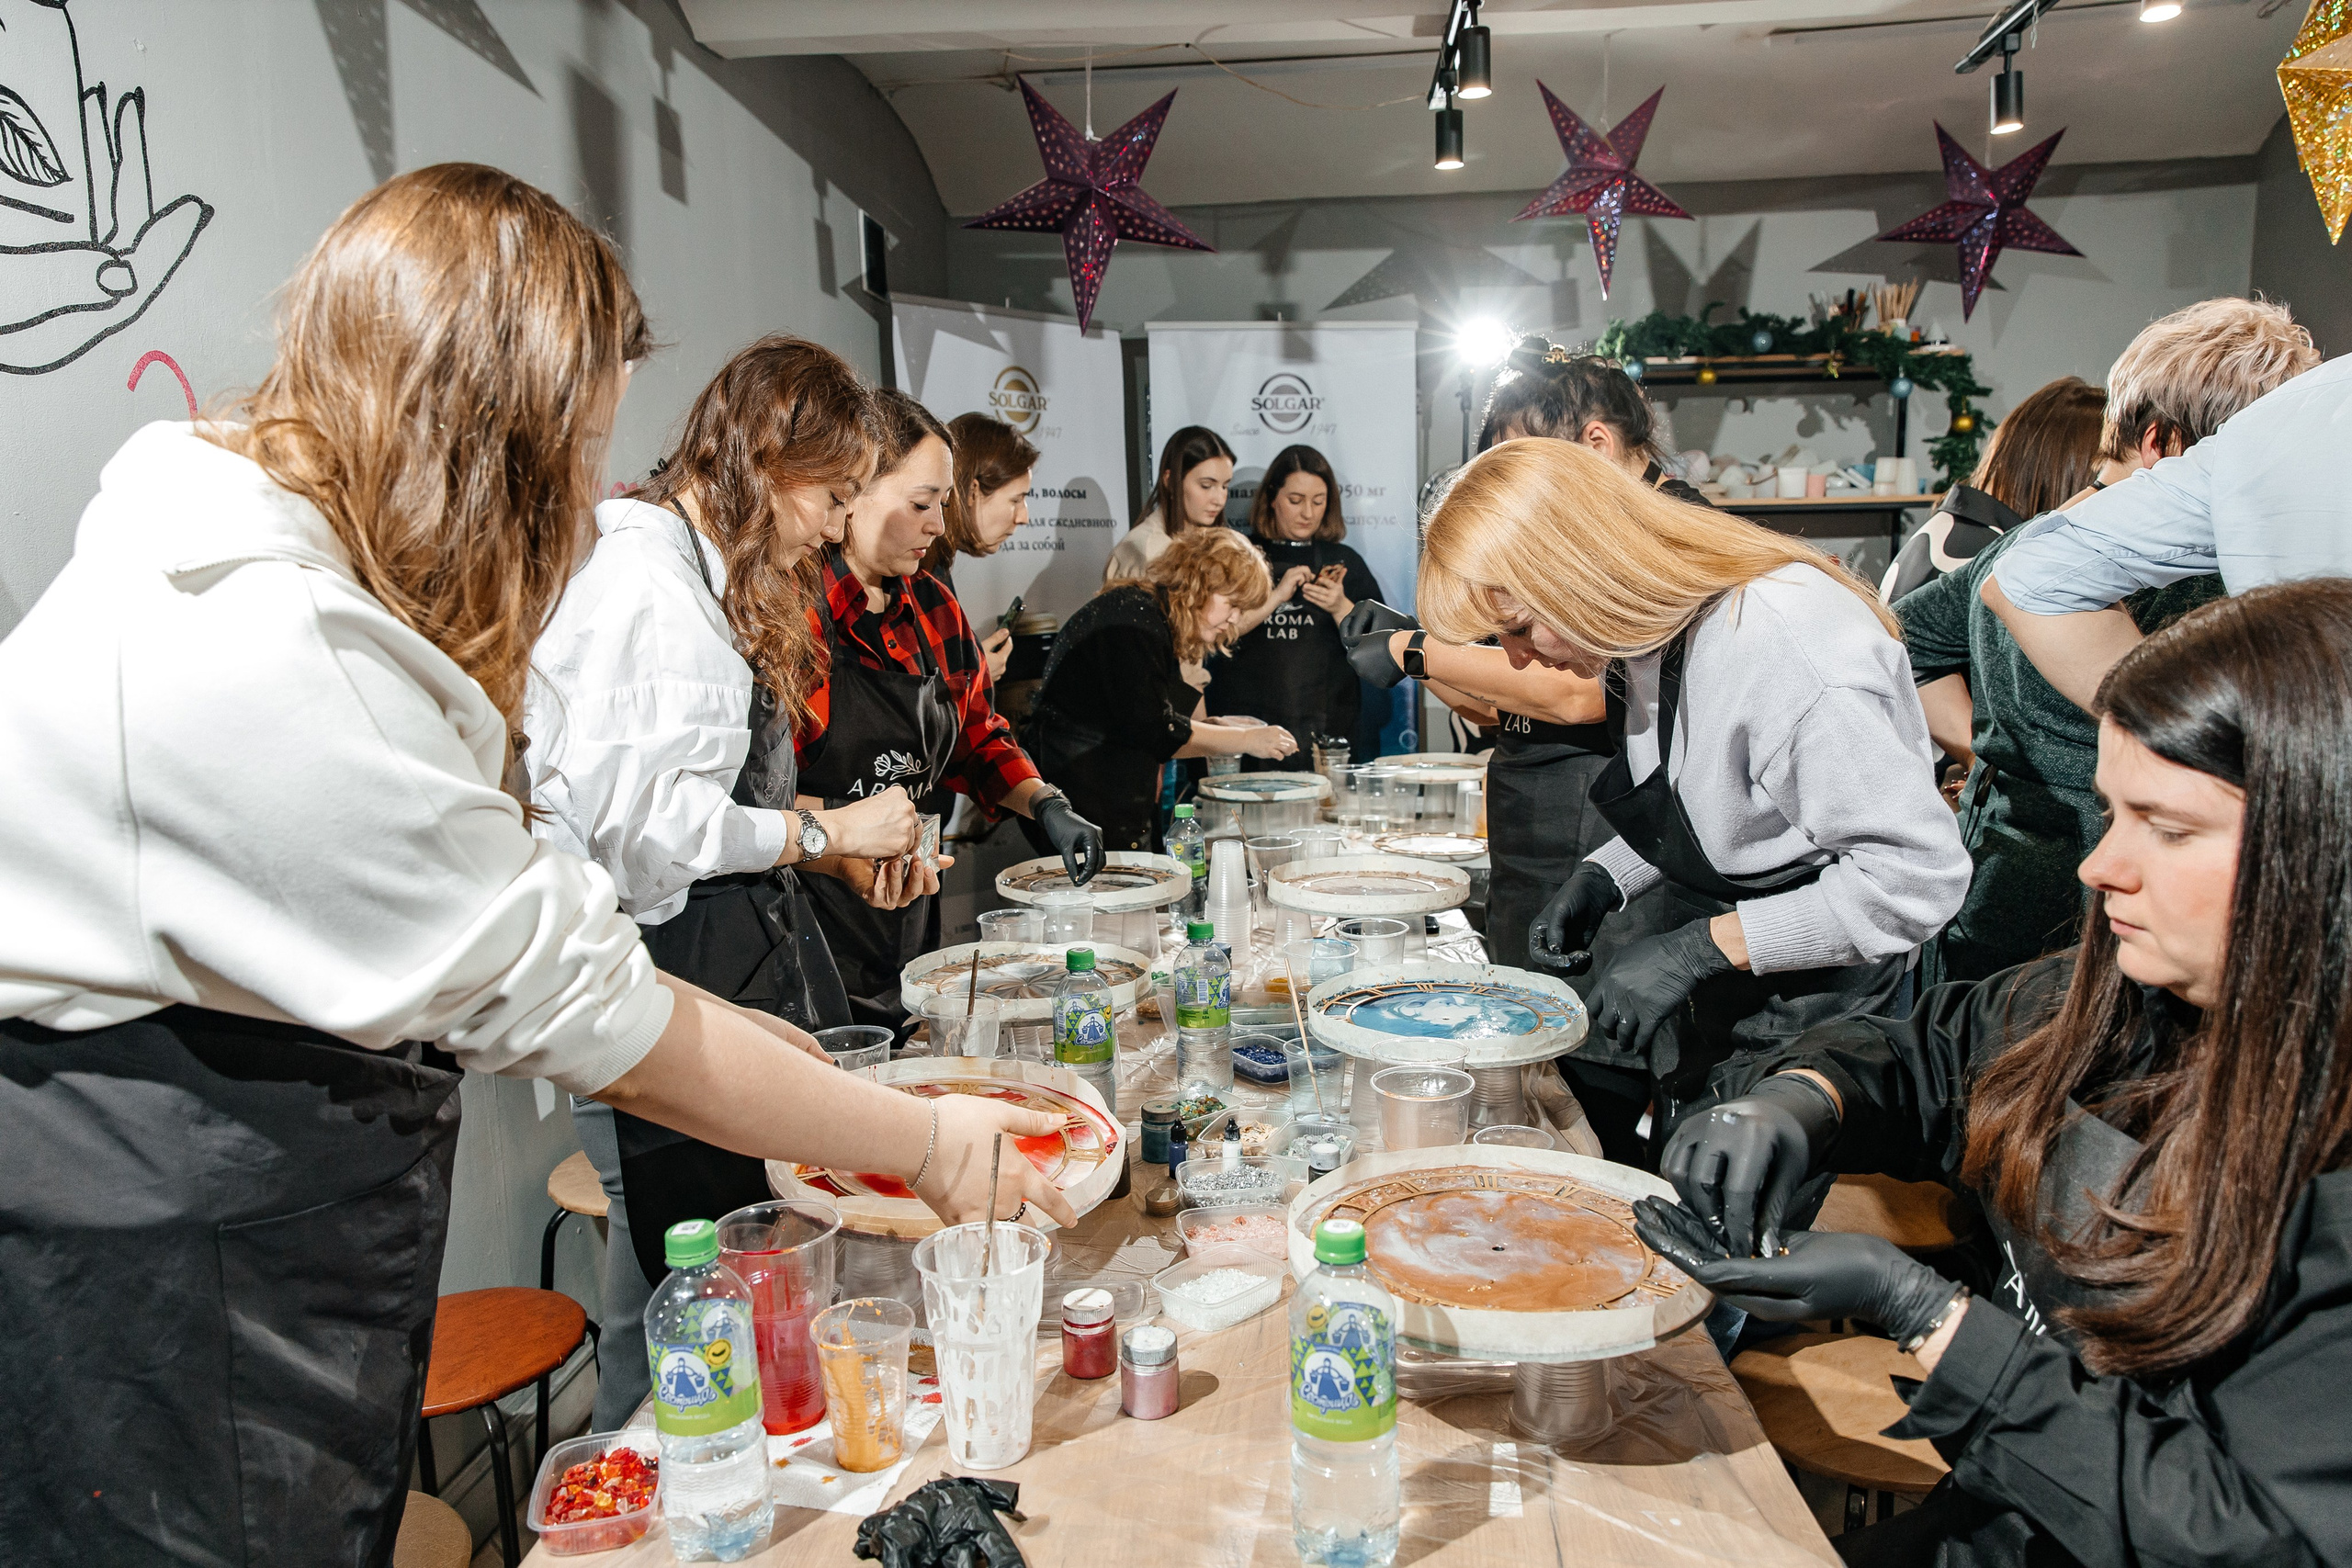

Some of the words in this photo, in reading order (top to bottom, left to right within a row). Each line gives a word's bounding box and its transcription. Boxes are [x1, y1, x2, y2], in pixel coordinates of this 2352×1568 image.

[989, 391, 1046, 411] SOLGAR
[1250, 397, 1321, 411] SOLGAR
[1042, 489, 1087, 499] волосы
[1032, 536, 1065, 550] собой
[1267, 627, 1298, 639] LAB
[847, 778, 933, 800] ARMA
